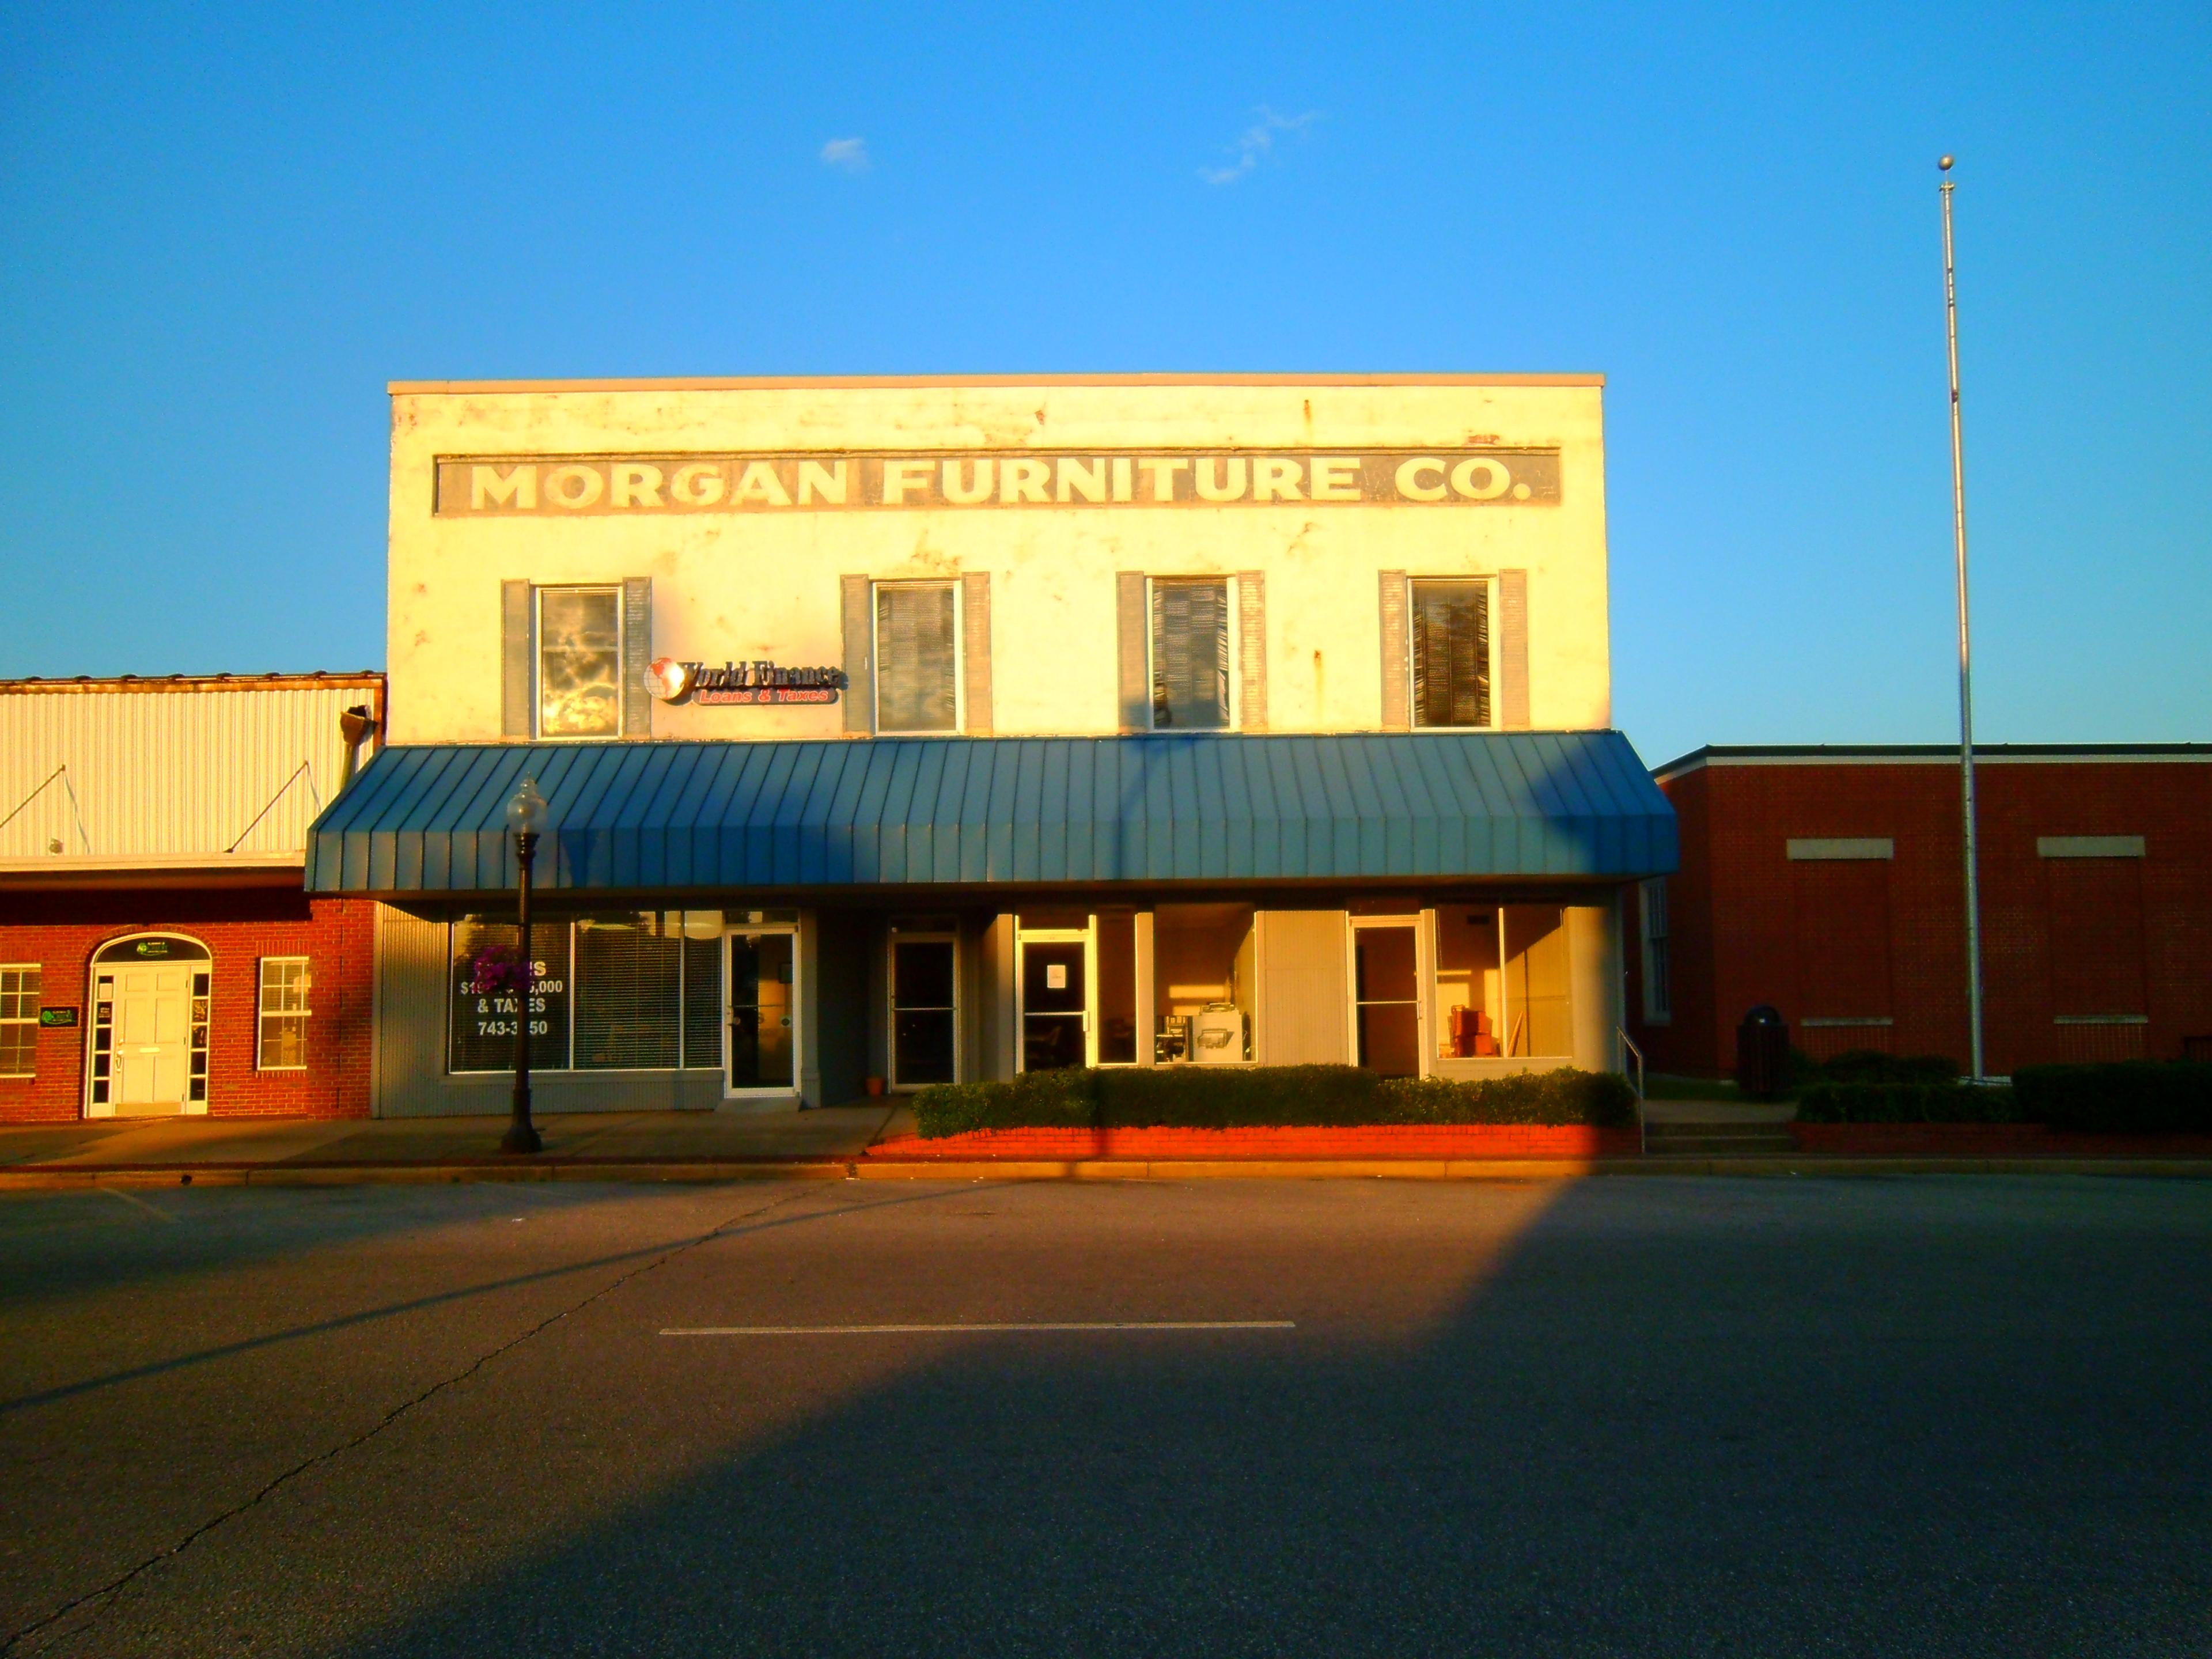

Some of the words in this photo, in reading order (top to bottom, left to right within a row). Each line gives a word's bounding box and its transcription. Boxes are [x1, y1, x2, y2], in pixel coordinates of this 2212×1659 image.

[470, 461, 847, 510] MORGAN
[882, 457, 1361, 505] FURNITURE
[1395, 457, 1531, 501] CO.
[676, 661, 747, 687] World
[752, 660, 840, 685] Finance
[699, 690, 753, 703] Loans
[757, 688, 771, 702] &
[777, 688, 828, 702] Taxes
[477, 998, 489, 1013] &
[478, 1021, 548, 1036] 743-350
